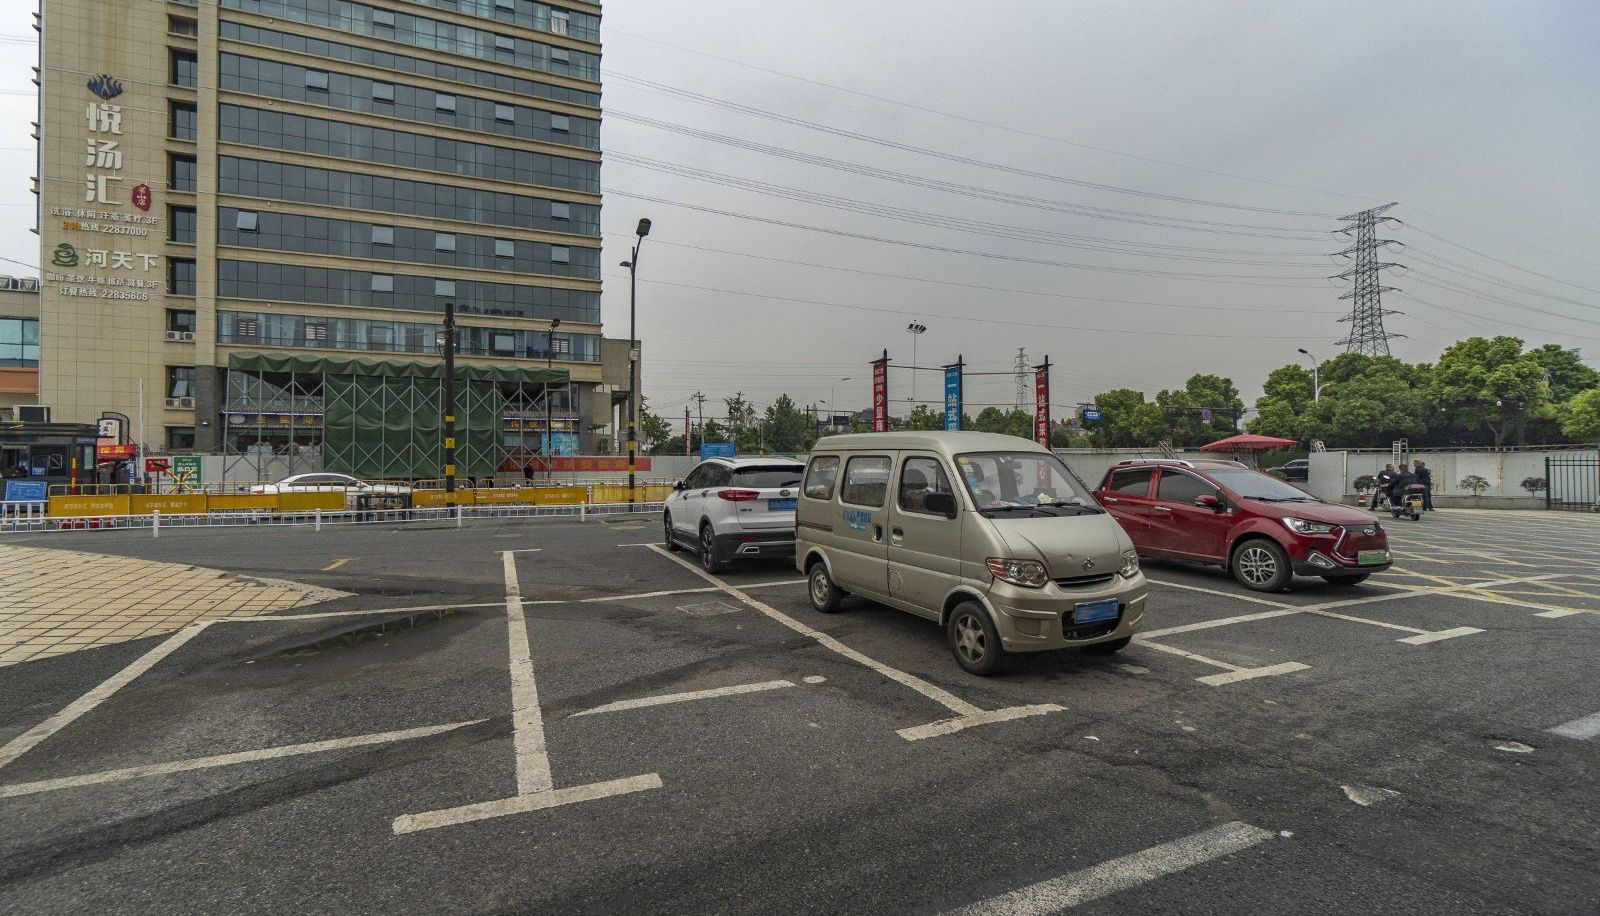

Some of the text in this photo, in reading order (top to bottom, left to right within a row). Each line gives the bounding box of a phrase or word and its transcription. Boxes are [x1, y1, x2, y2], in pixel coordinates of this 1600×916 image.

[86, 103, 122, 205] 悦汤汇
[50, 206, 72, 217] 洗浴
[77, 209, 96, 219] 休闲
[102, 224, 147, 236] 22837000
[85, 248, 158, 272] 河天下
[59, 286, 98, 298] 订餐热线
